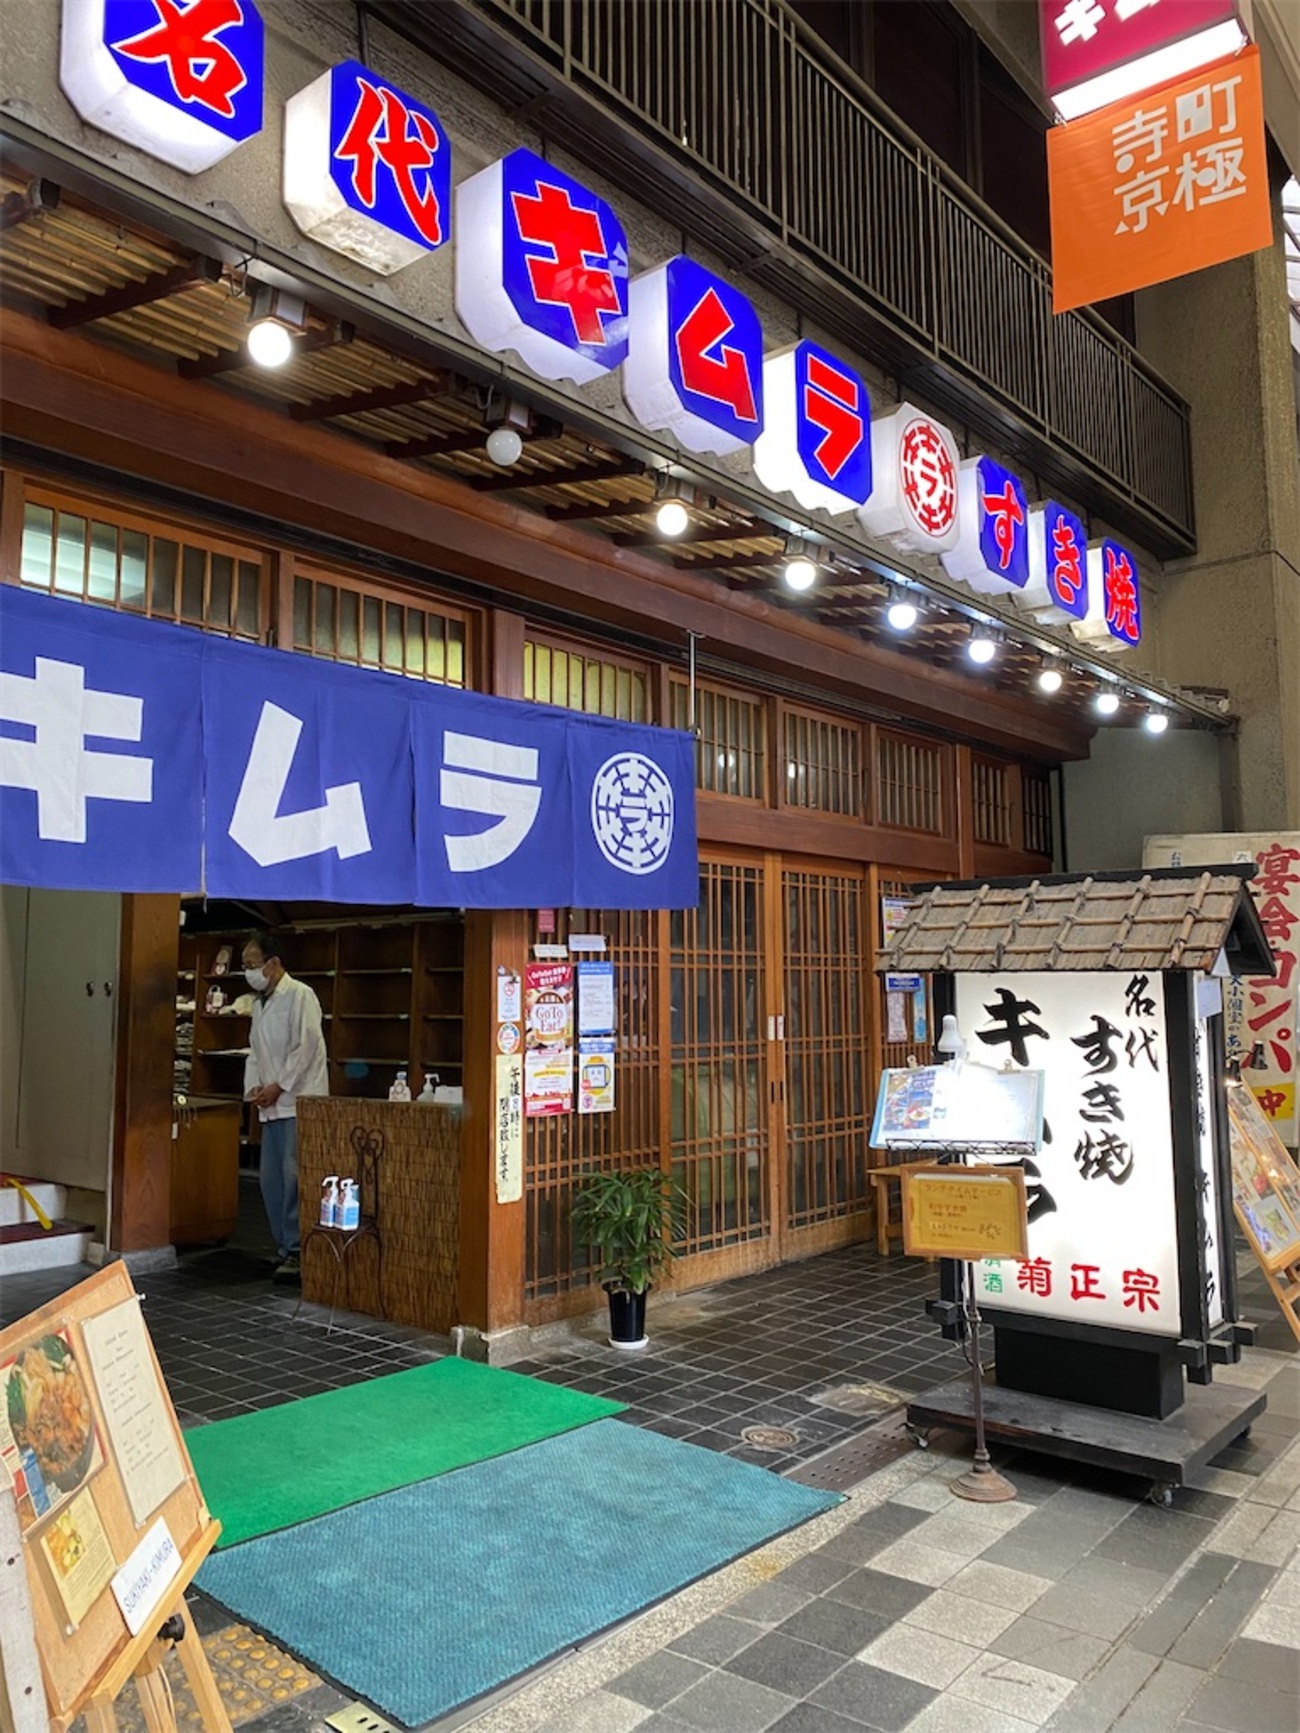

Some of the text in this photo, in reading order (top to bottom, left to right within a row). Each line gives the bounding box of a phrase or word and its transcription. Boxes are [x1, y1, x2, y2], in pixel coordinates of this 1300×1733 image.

[1112, 75, 1243, 173] 寺町
[1114, 137, 1247, 235] 京極
[982, 480, 1140, 640] すき焼
[0, 656, 543, 872] キムラ
[1125, 974, 1160, 1073] 名代
[1070, 1014, 1134, 1186] すき焼
[1017, 1257, 1160, 1313] 菊正宗
